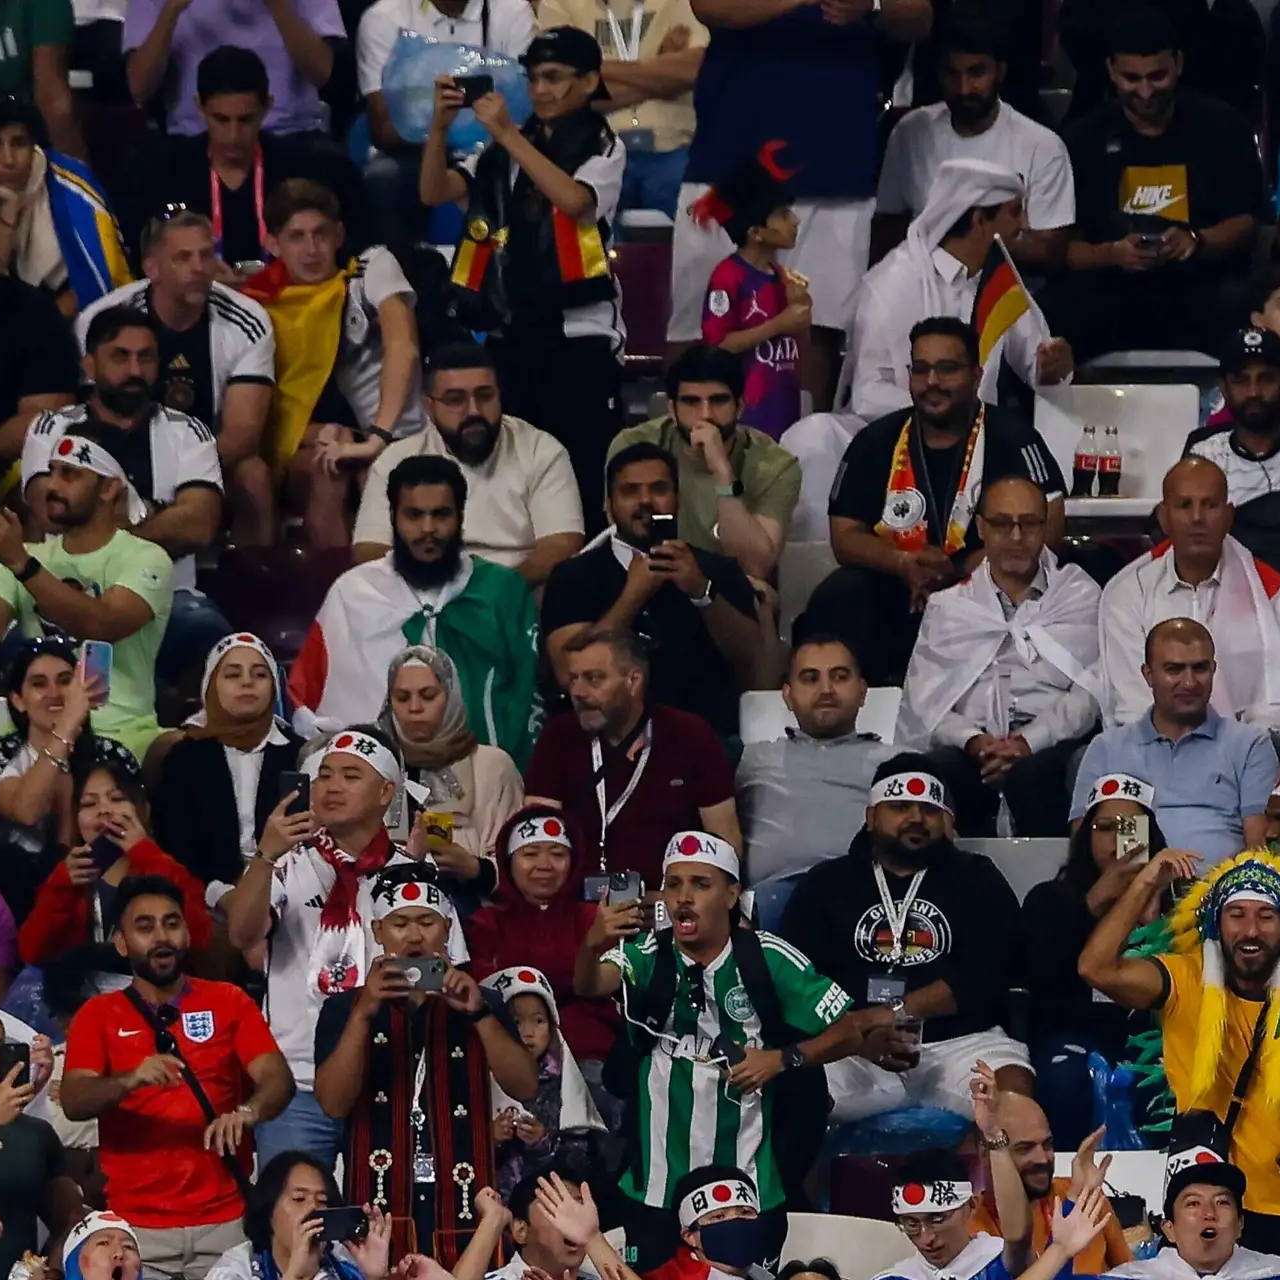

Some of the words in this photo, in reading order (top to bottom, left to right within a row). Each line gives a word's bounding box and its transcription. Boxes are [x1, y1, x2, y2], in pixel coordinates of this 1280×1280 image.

[1132, 185, 1173, 206] NIKE
[756, 337, 799, 367] QATA
[815, 981, 842, 1019] PRO
[691, 1182, 753, 1214] 日本
